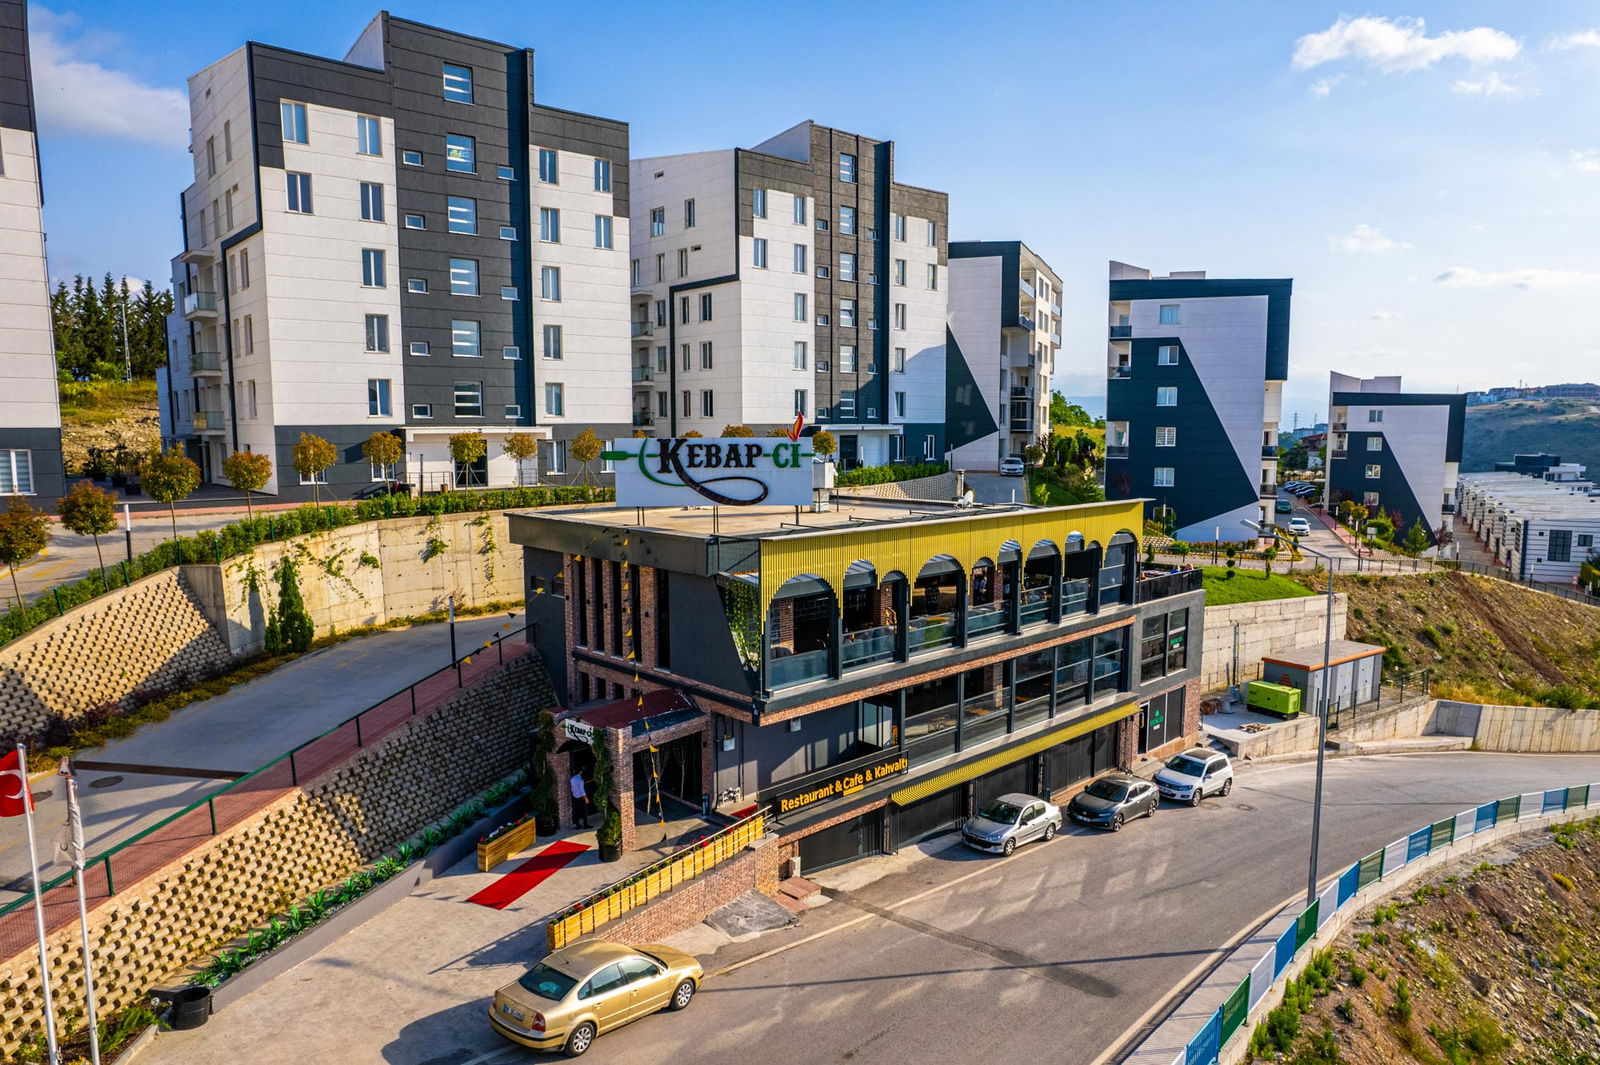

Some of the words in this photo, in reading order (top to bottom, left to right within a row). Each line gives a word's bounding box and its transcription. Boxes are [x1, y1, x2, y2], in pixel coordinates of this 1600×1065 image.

[781, 783, 834, 812] Restaurant
[835, 780, 843, 793] &
[843, 773, 864, 790] Cafe
[865, 769, 873, 782] &
